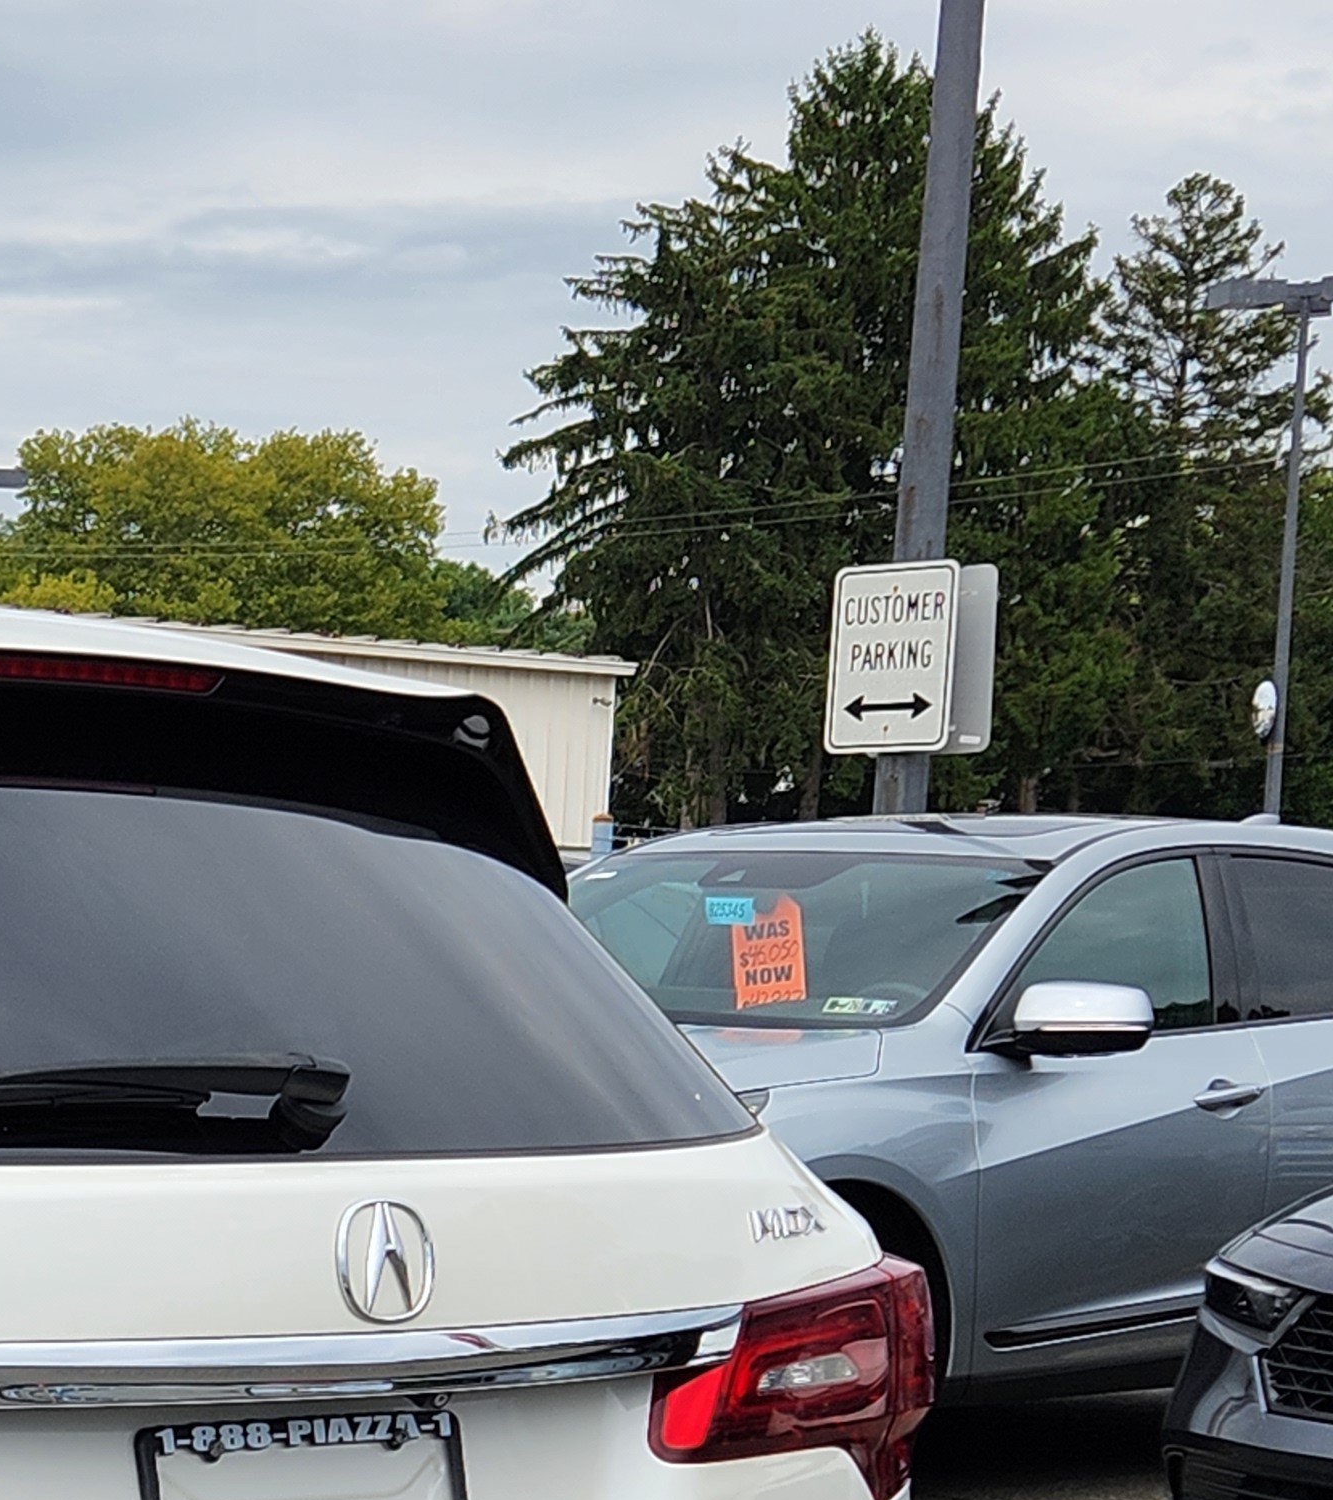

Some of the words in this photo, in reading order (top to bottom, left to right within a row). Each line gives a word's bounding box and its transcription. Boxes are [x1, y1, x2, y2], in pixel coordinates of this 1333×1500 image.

[844, 591, 946, 626] CUSTOMER
[850, 639, 933, 672] PARKING
[743, 919, 791, 941] WAS
[744, 964, 794, 986] NOW
[155, 1411, 453, 1453] 1-888-PIAZZA-1
